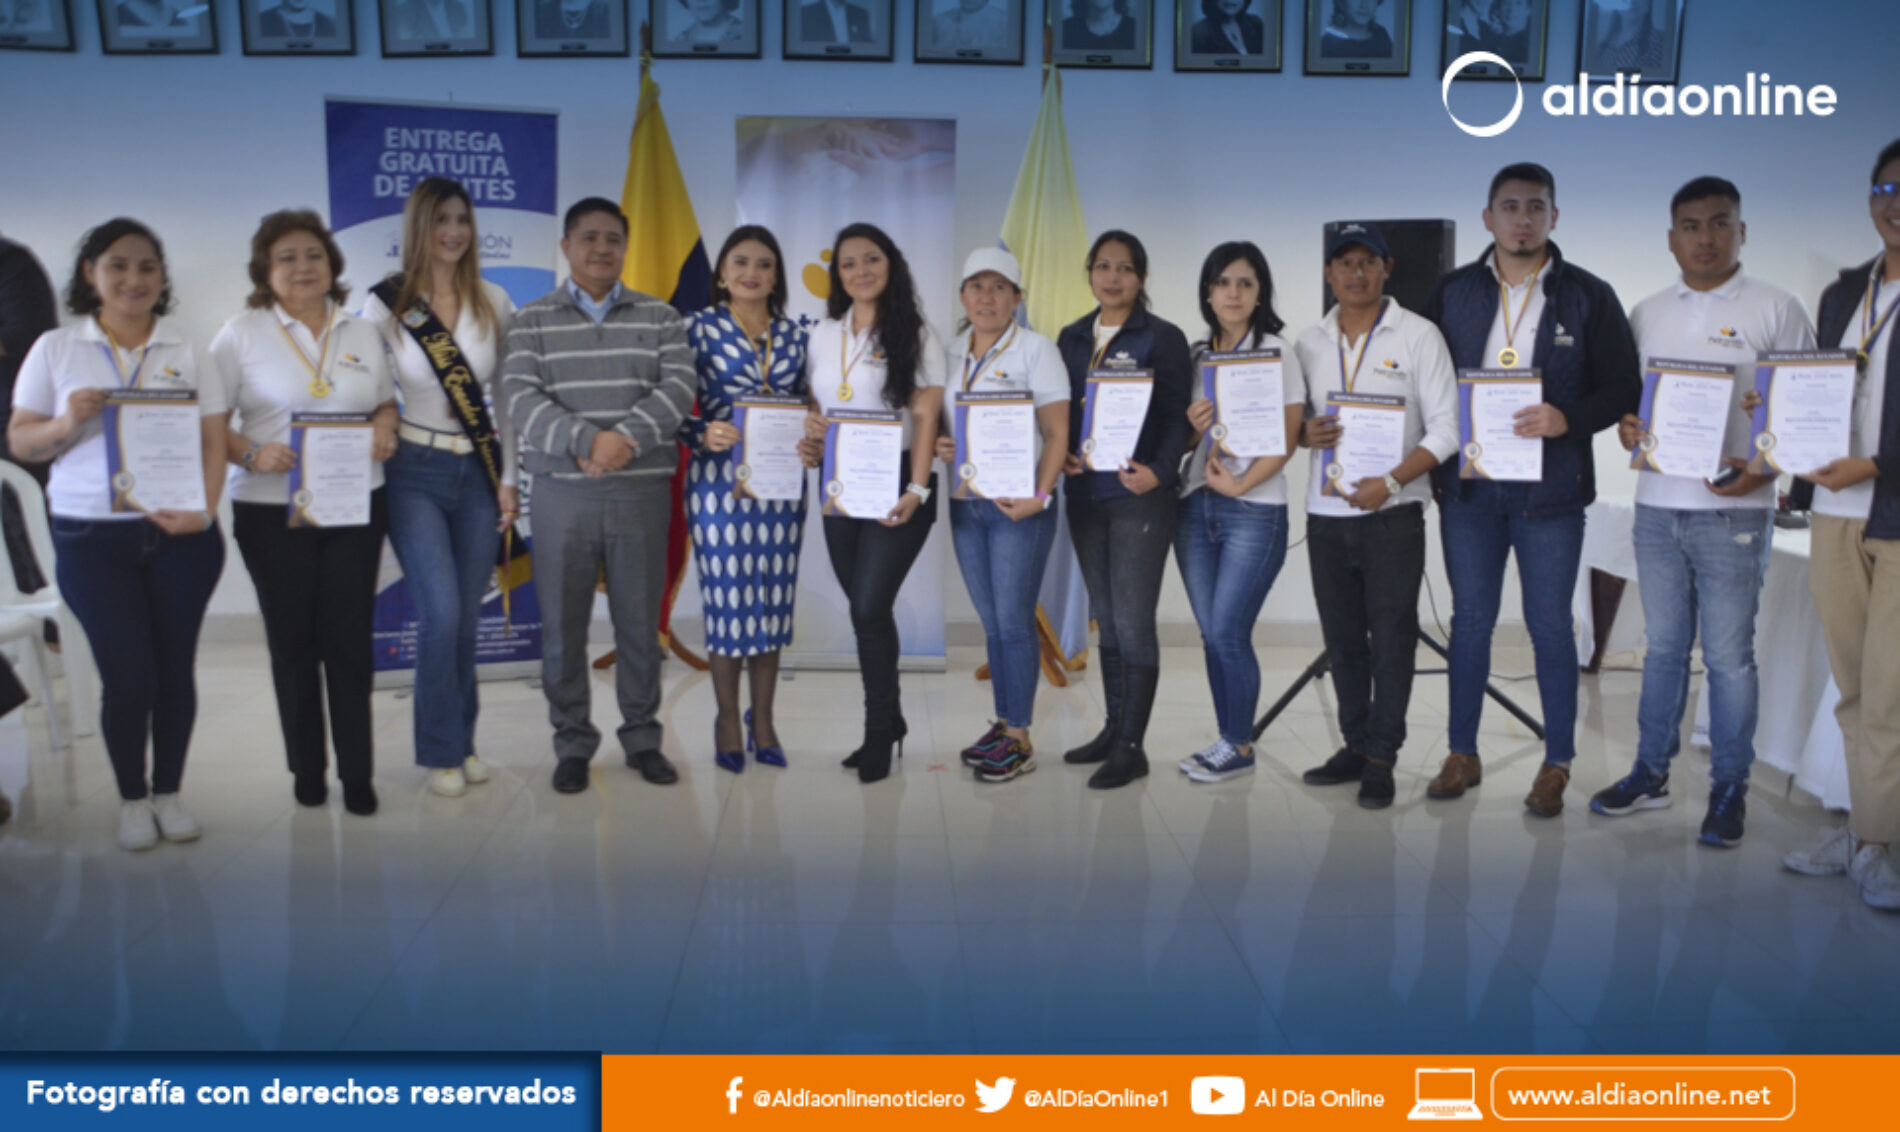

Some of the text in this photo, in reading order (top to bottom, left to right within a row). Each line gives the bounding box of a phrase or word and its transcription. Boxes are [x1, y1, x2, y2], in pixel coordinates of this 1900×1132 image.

[385, 127, 504, 153] ENTREGA
[379, 151, 510, 176] GRATUITA
[373, 174, 413, 198] DE
